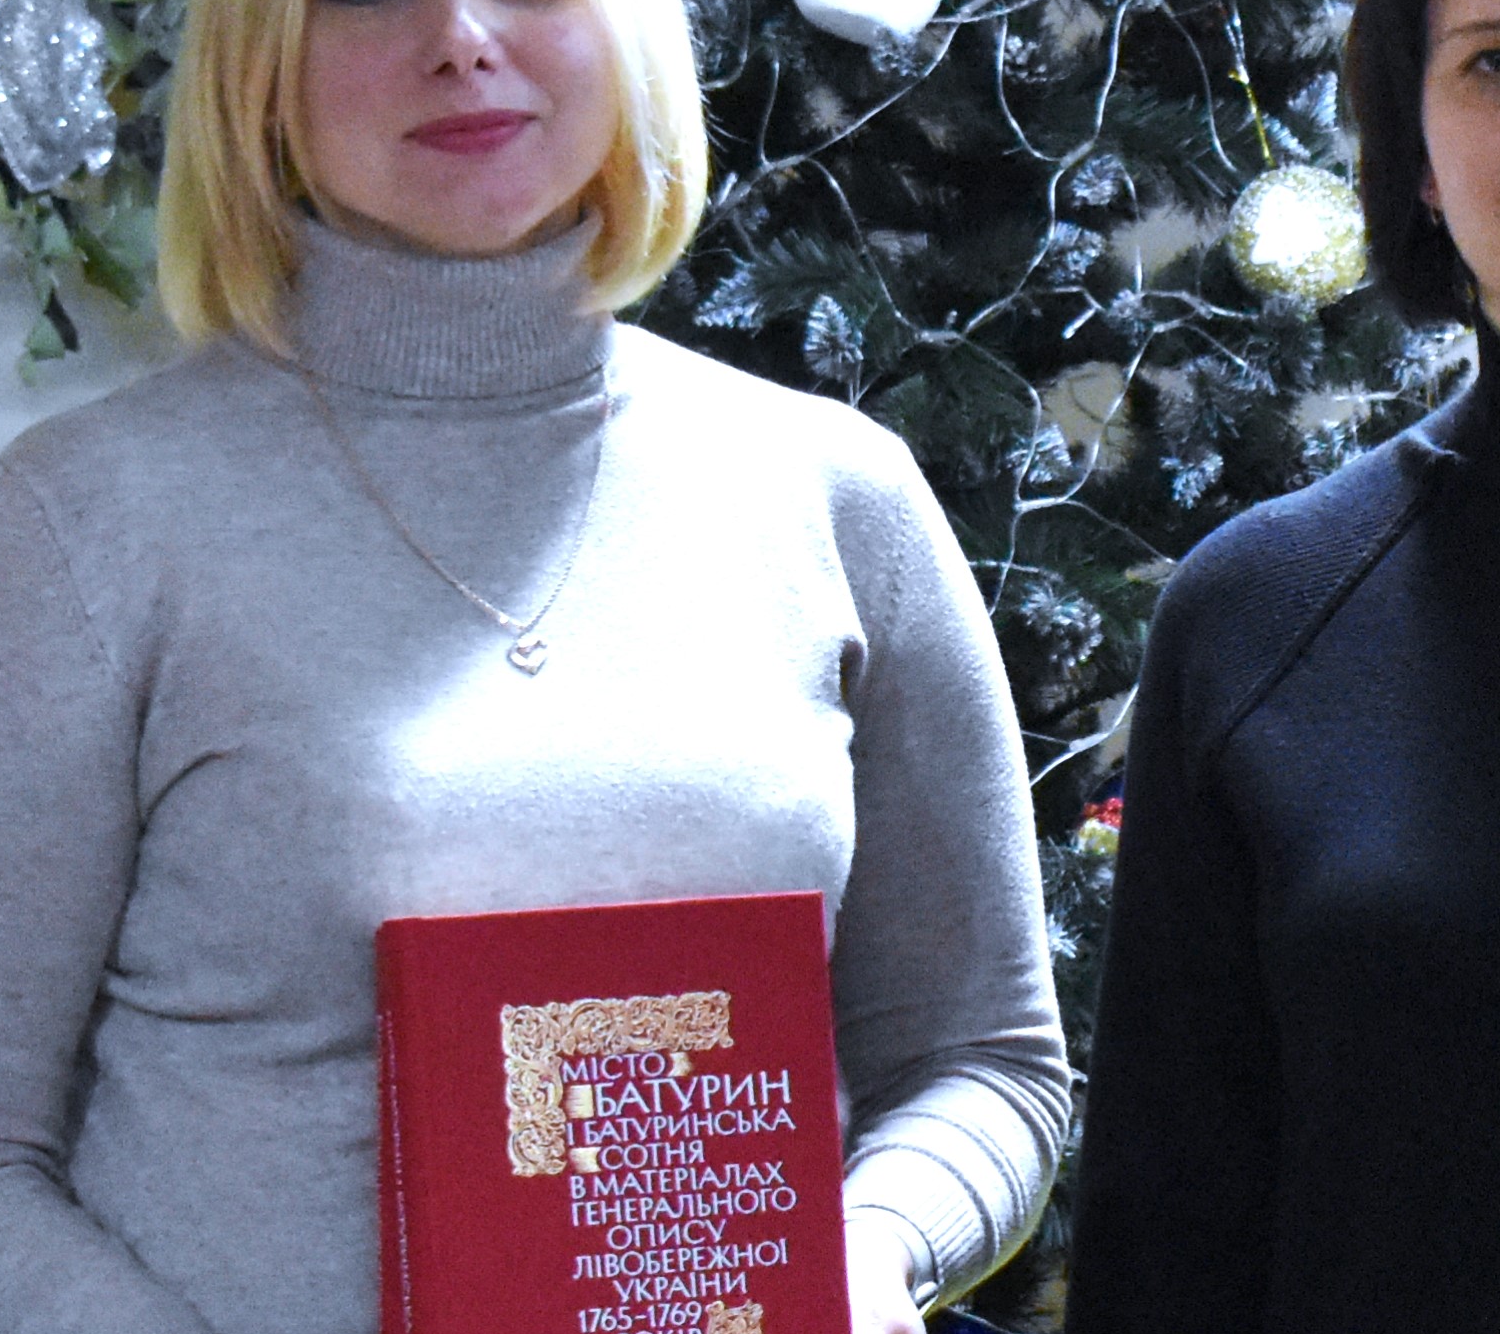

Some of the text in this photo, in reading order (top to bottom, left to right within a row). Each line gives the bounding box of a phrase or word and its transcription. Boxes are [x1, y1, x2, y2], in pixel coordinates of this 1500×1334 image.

[562, 1052, 665, 1082] МІСТО
[595, 1069, 791, 1117] БАТУРИН
[566, 1108, 796, 1145] І БАТУРИНСЬКА
[601, 1139, 705, 1169] СОТНЯ
[570, 1161, 785, 1199] В МАТЕРІАЛАХ
[571, 1187, 797, 1226] ГЕНЕРАЛЬНОГО
[607, 1218, 727, 1250] ОПИСУ
[578, 1301, 702, 1333] 1765-1769
